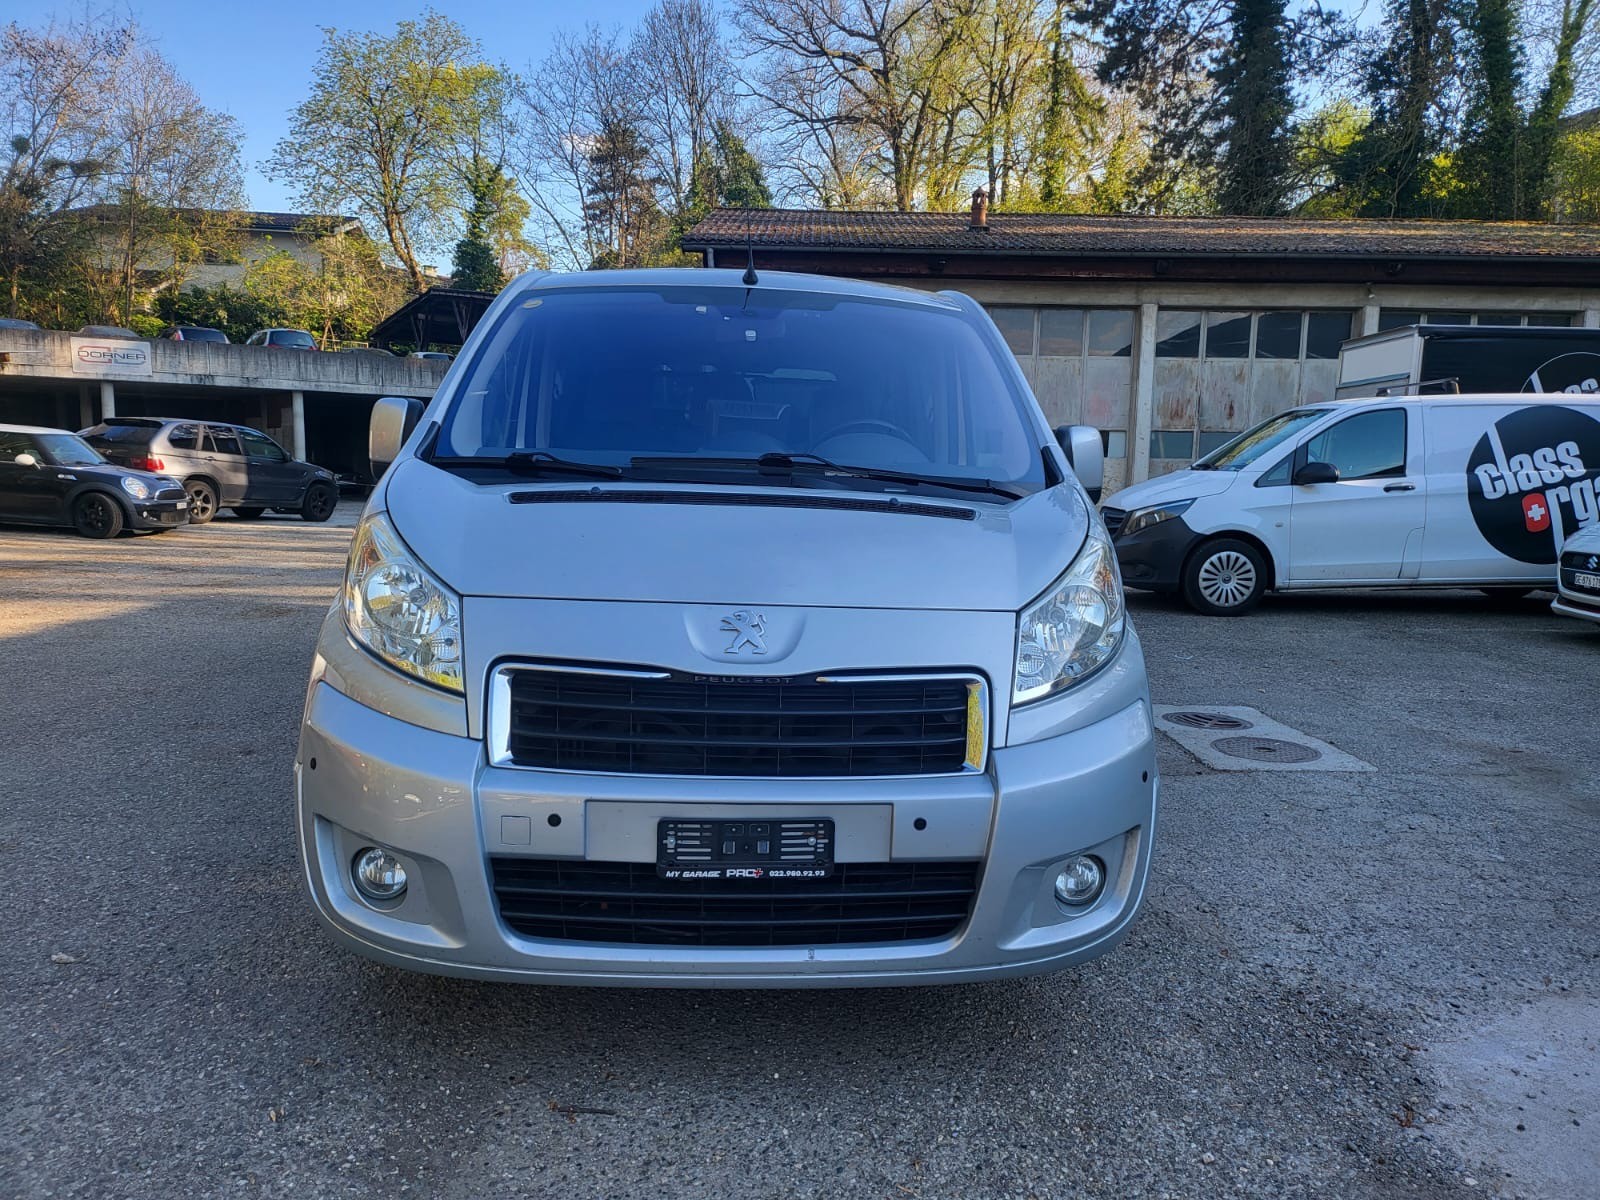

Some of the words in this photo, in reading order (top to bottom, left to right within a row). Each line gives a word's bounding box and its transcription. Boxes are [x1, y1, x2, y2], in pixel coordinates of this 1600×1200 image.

[77, 350, 147, 361] DORNER
[694, 675, 793, 684] PEUGEOT
[665, 870, 681, 878] MY
[682, 870, 721, 878] GARAGE
